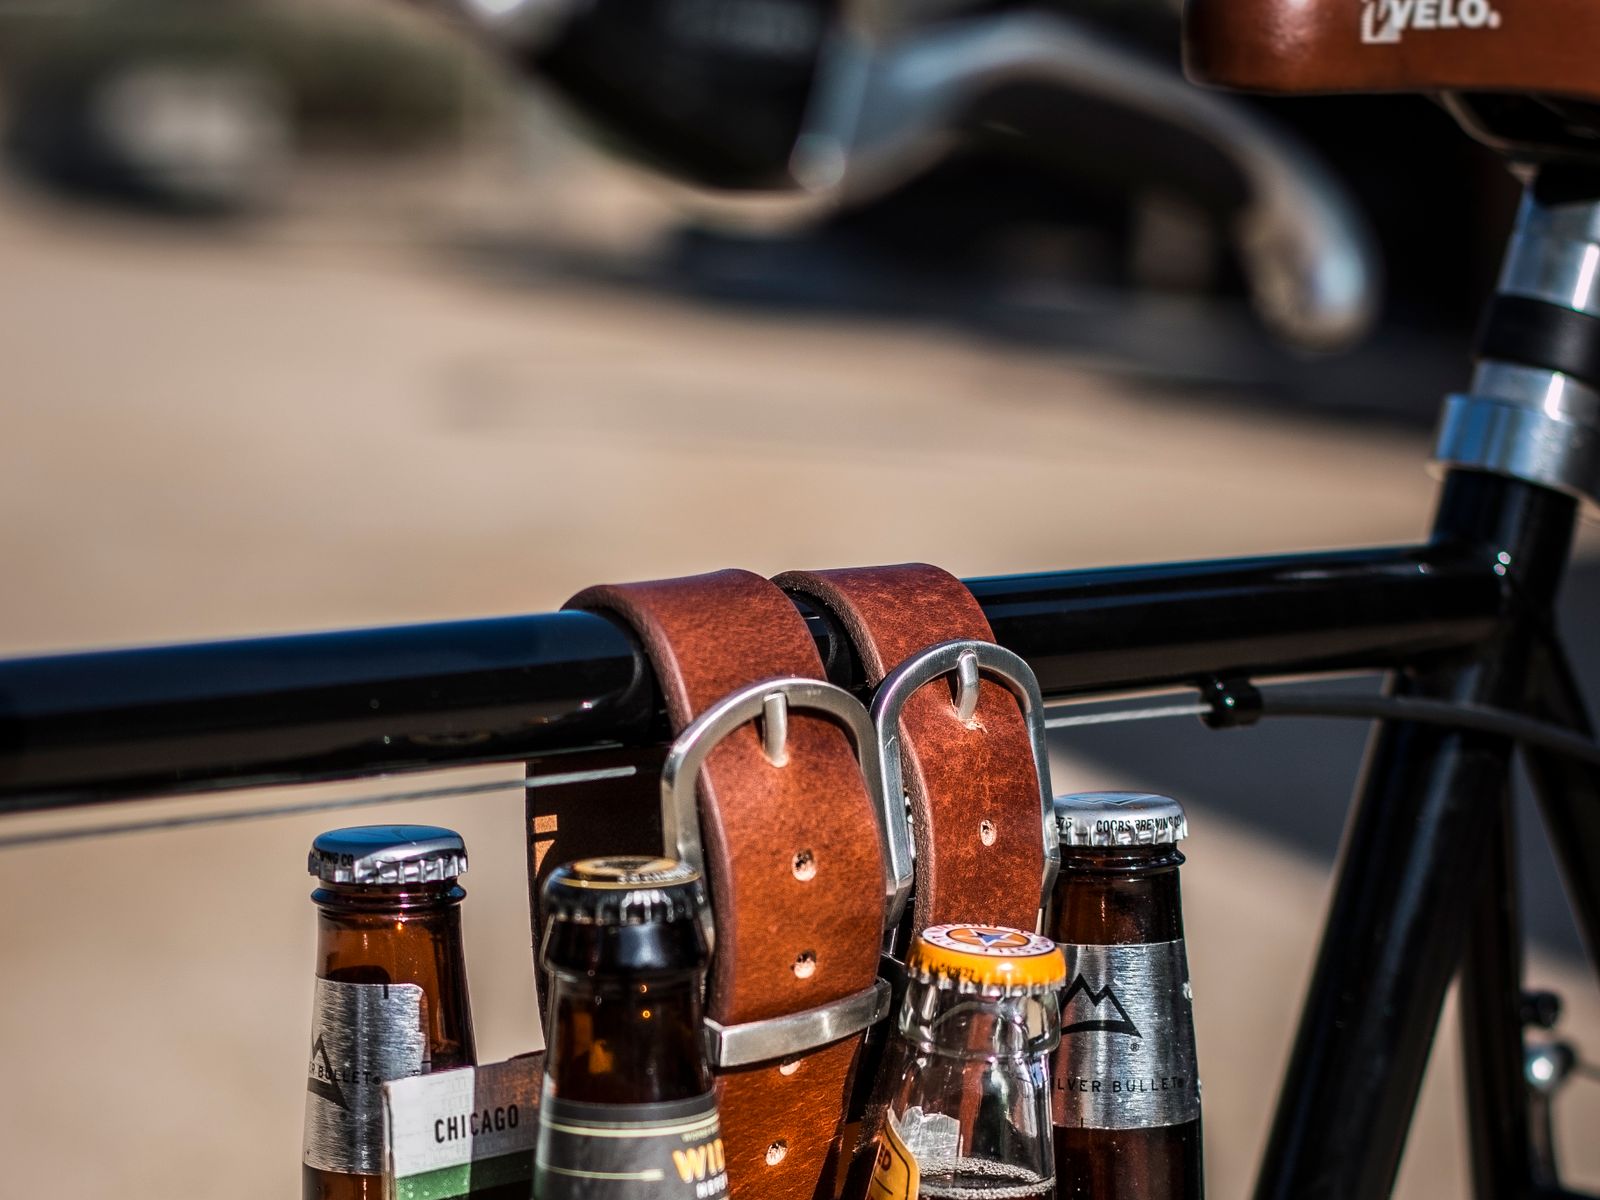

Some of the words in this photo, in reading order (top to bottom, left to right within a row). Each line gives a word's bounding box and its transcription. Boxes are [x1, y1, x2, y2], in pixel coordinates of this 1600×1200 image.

[1051, 1077, 1101, 1093] ILVER
[1112, 1076, 1177, 1093] BULLET
[434, 1104, 519, 1144] CHICAGO
